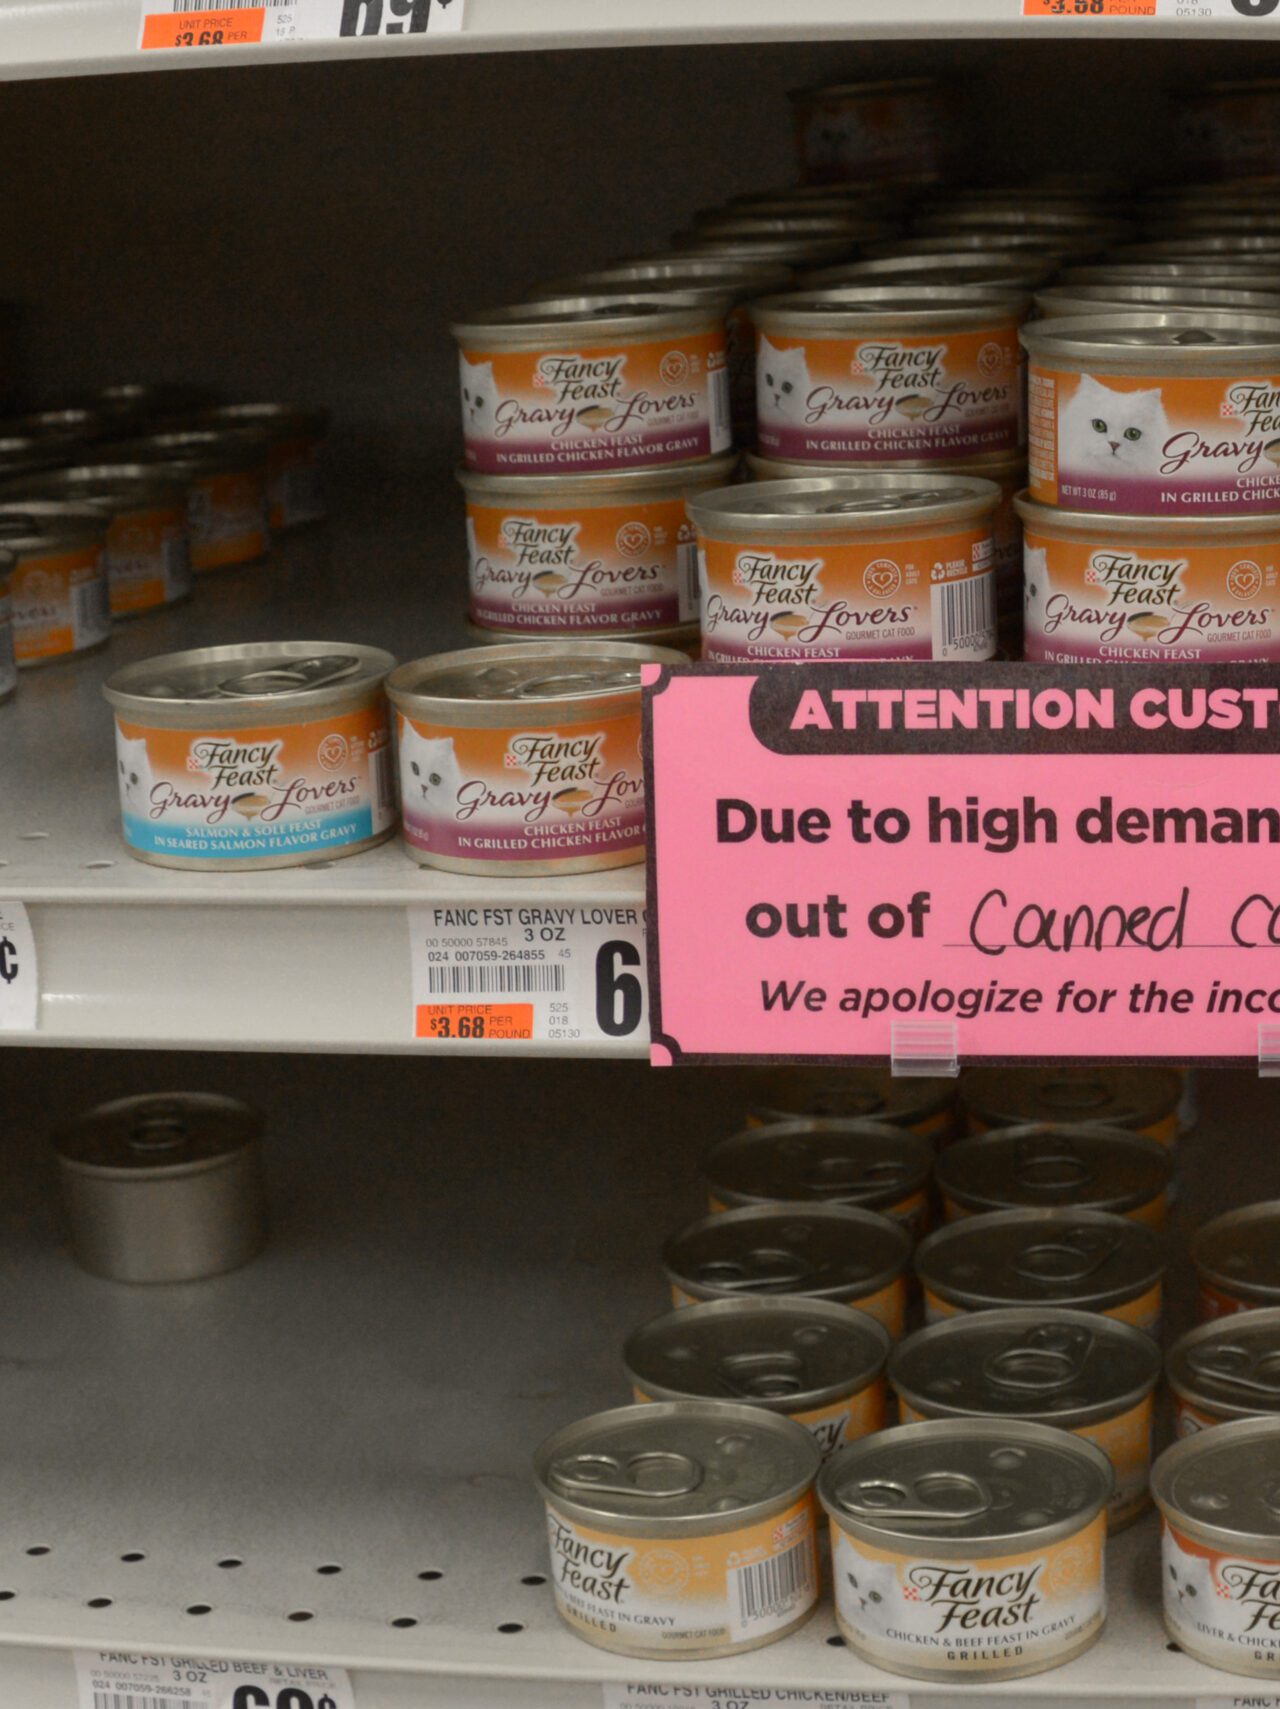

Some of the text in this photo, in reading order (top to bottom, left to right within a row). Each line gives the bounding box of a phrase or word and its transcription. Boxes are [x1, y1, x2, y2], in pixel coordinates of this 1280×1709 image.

[179, 17, 233, 30] UNIT PRICE
[540, 355, 624, 381] Fancy
[858, 346, 944, 371] Fancy
[557, 378, 621, 404] Feast
[874, 368, 942, 392] Feast
[503, 520, 578, 547] Fancy
[514, 543, 576, 567] Feast
[738, 555, 821, 585] Fancy
[1092, 555, 1183, 588] Fancy
[752, 580, 817, 606] Feast
[1106, 580, 1181, 606] Feast
[706, 594, 911, 643] Gravy Lovers
[1044, 594, 1269, 645] Gravy Lovers
[747, 646, 840, 658] CHICKEN FEAST
[1099, 646, 1202, 659] CHICKEN FEAST
[790, 688, 1114, 730] ATTENTION
[193, 742, 278, 769] Fancy
[512, 735, 602, 763] Fancy
[207, 764, 279, 790] Feast
[530, 758, 600, 787] Feast
[150, 777, 356, 824] Gravy Lovers
[458, 825, 640, 849] IN GRILLED CHICKEN FLAVOR
[524, 817, 621, 836] CHICKEN FEAST
[715, 798, 831, 844] Due
[848, 800, 911, 844] to
[928, 796, 1058, 853] high
[434, 908, 638, 926] FANC FST GRAVY LOVER
[745, 891, 931, 938] out of
[969, 886, 1190, 956] Canned
[426, 939, 438, 947] 00
[441, 938, 473, 947] 50000
[524, 928, 566, 941] 3 OZ
[428, 952, 449, 962] 024
[455, 950, 545, 962] 007059-264855
[428, 1004, 493, 1016] UNIT PRICE
[549, 1003, 569, 1012] 525
[761, 980, 827, 1012] We
[838, 980, 1043, 1019] apologize
[1056, 981, 1116, 1013] for
[1128, 981, 1193, 1013] the
[430, 1016, 513, 1039] $3.68 PER
[549, 1016, 569, 1025] 018
[489, 1029, 531, 1039] POUND
[548, 1029, 580, 1039] 05130
[909, 1563, 1042, 1602] Fancy
[930, 1592, 1041, 1634] Feast
[886, 1615, 1076, 1648] CHICKEN & BEEF FEAST IN GRAVY
[947, 1646, 1023, 1661] GRILLED
[170, 1657, 229, 1673] GRILLED
[233, 1662, 268, 1676] BEEF
[274, 1667, 283, 1677] &
[286, 1666, 328, 1681] LIVER
[174, 1671, 181, 1682] 3
[186, 1671, 207, 1684] OZ
